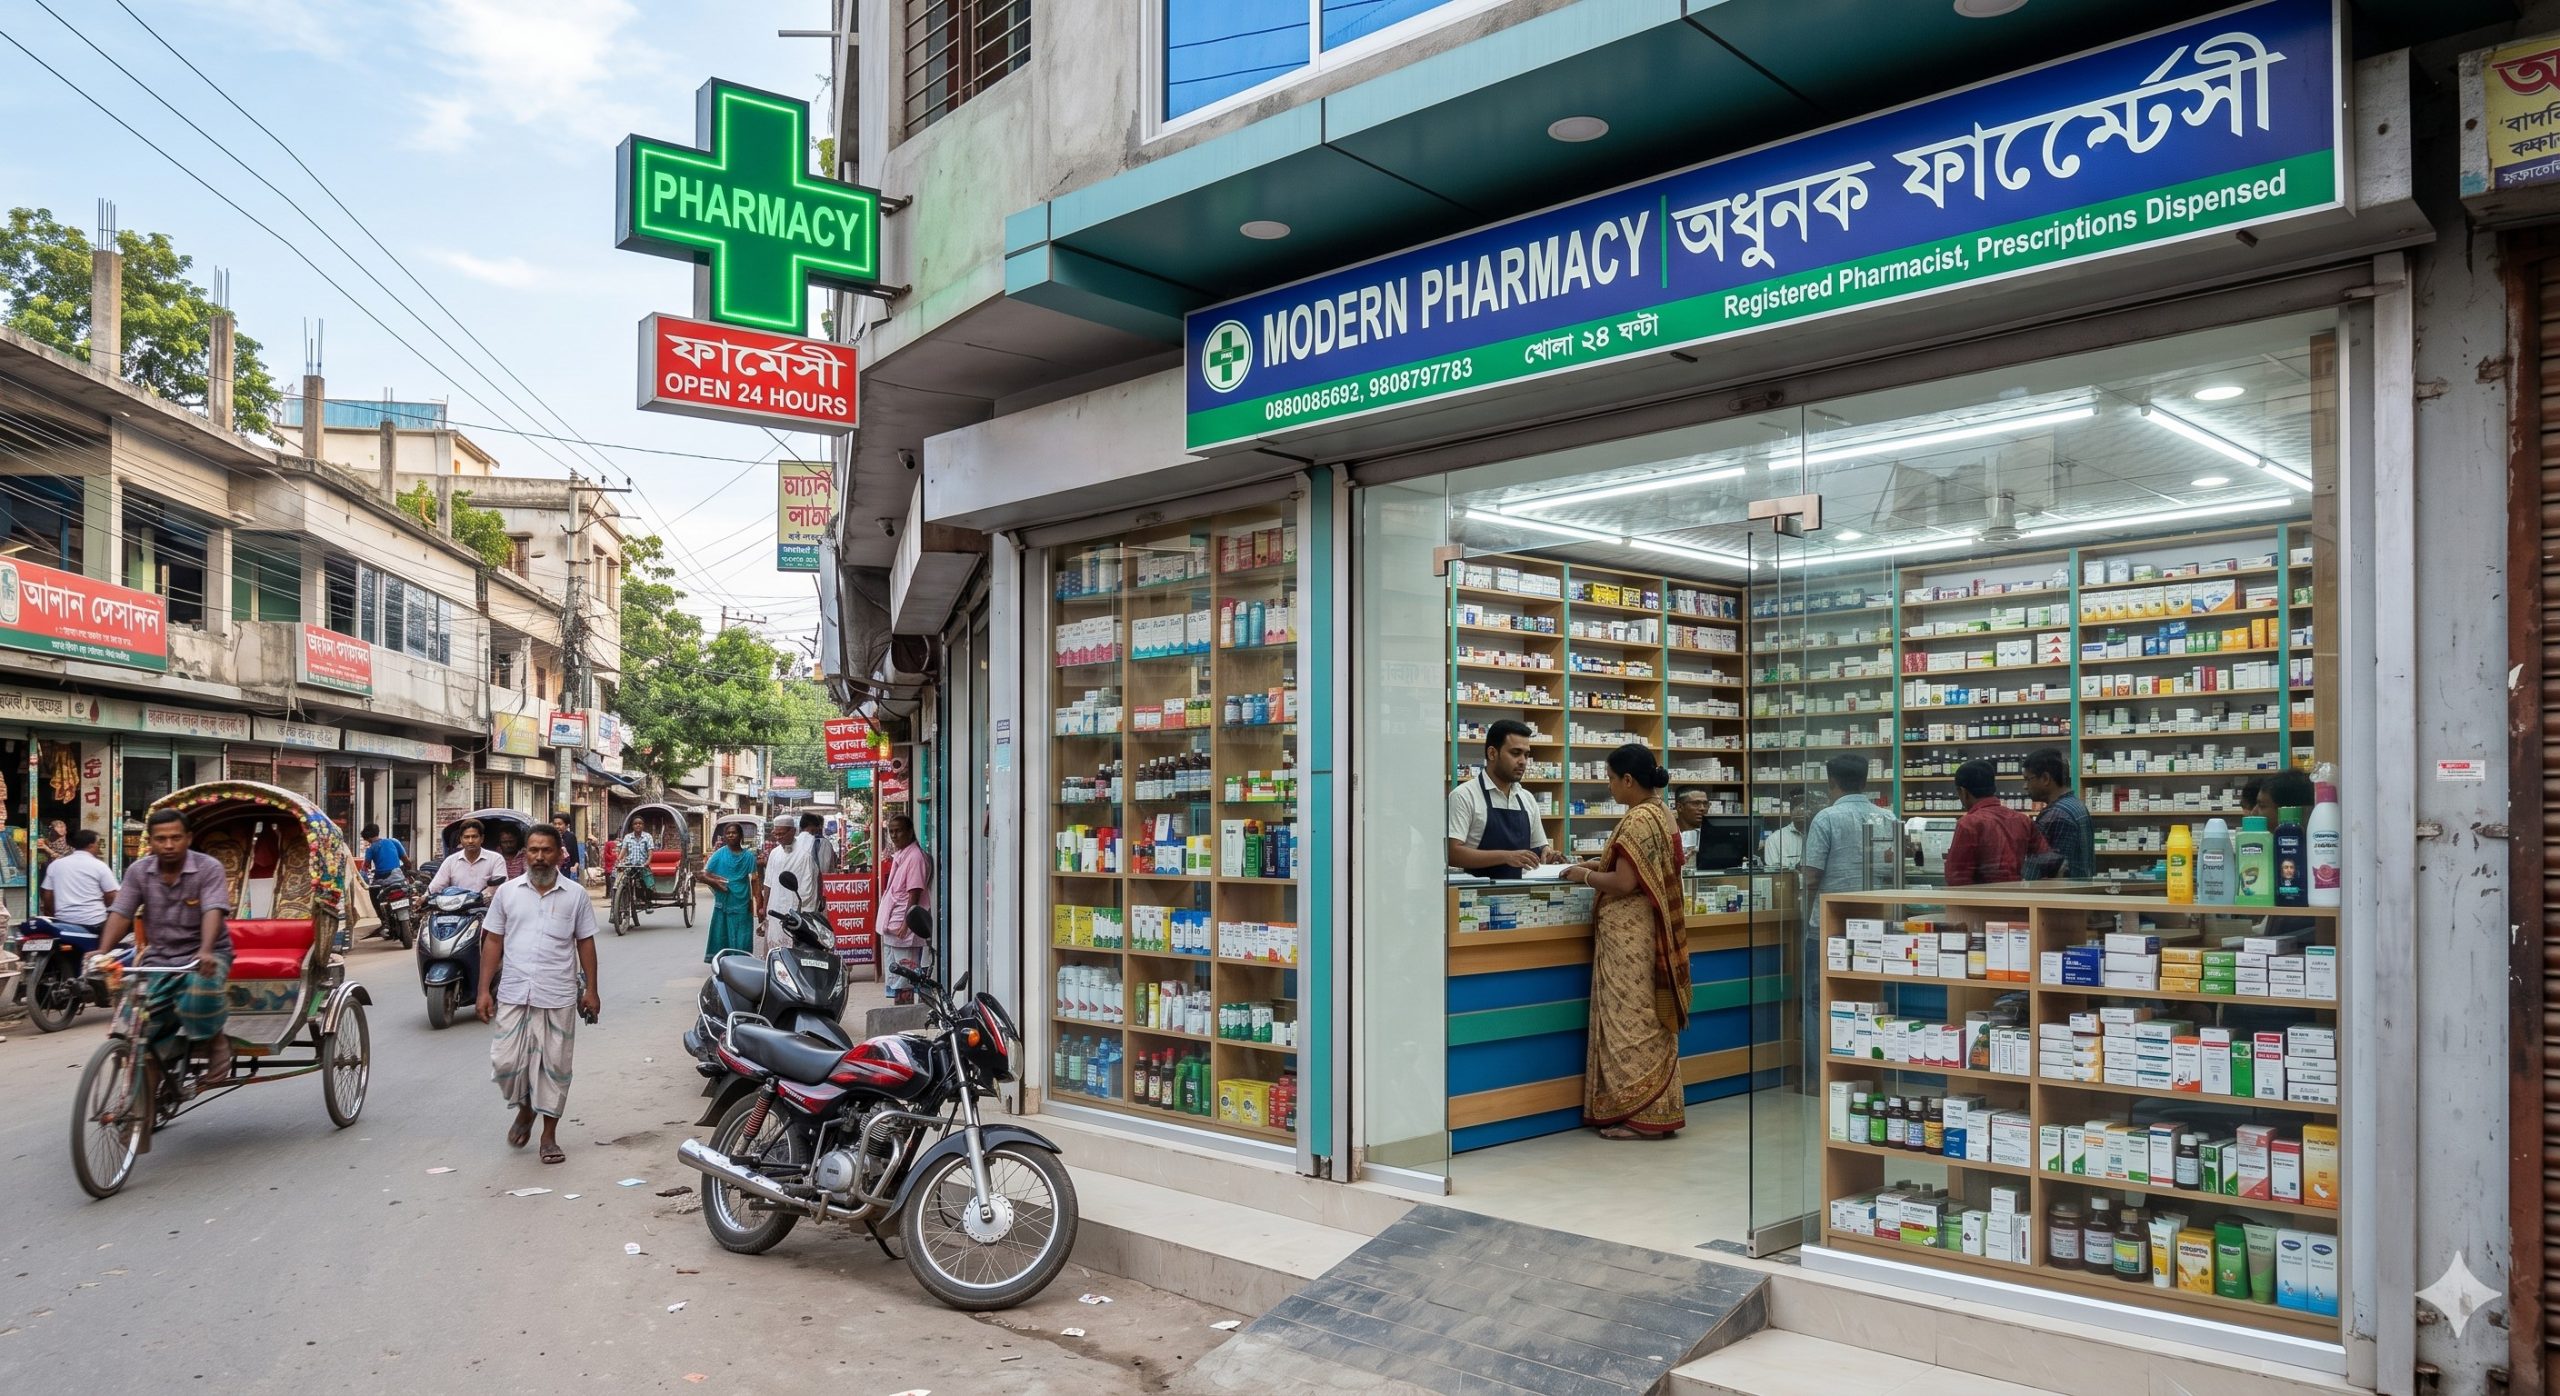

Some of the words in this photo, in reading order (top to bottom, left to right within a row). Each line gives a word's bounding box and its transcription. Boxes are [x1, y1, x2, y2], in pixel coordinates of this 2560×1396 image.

[654, 171, 859, 251] PHARMACY
[1724, 273, 1833, 319] Registered
[1839, 244, 1970, 295] Pharmacist,
[1977, 206, 2138, 263] Prescriptions
[2146, 168, 2287, 231] Dispensed
[1263, 277, 1408, 368] MODERN
[1422, 210, 1650, 329] PHARMACY
[664, 333, 848, 390] ফার্মেসী
[1525, 333, 1574, 364] খোলা
[1581, 326, 1610, 351] ২৪
[1617, 312, 1659, 341] ঘন্টা
[665, 373, 730, 400] OPEN
[738, 382, 763, 404] 24
[769, 387, 848, 416] HOURS
[1265, 382, 1364, 421] 0880085692,
[1369, 357, 1473, 398] 9808797783
